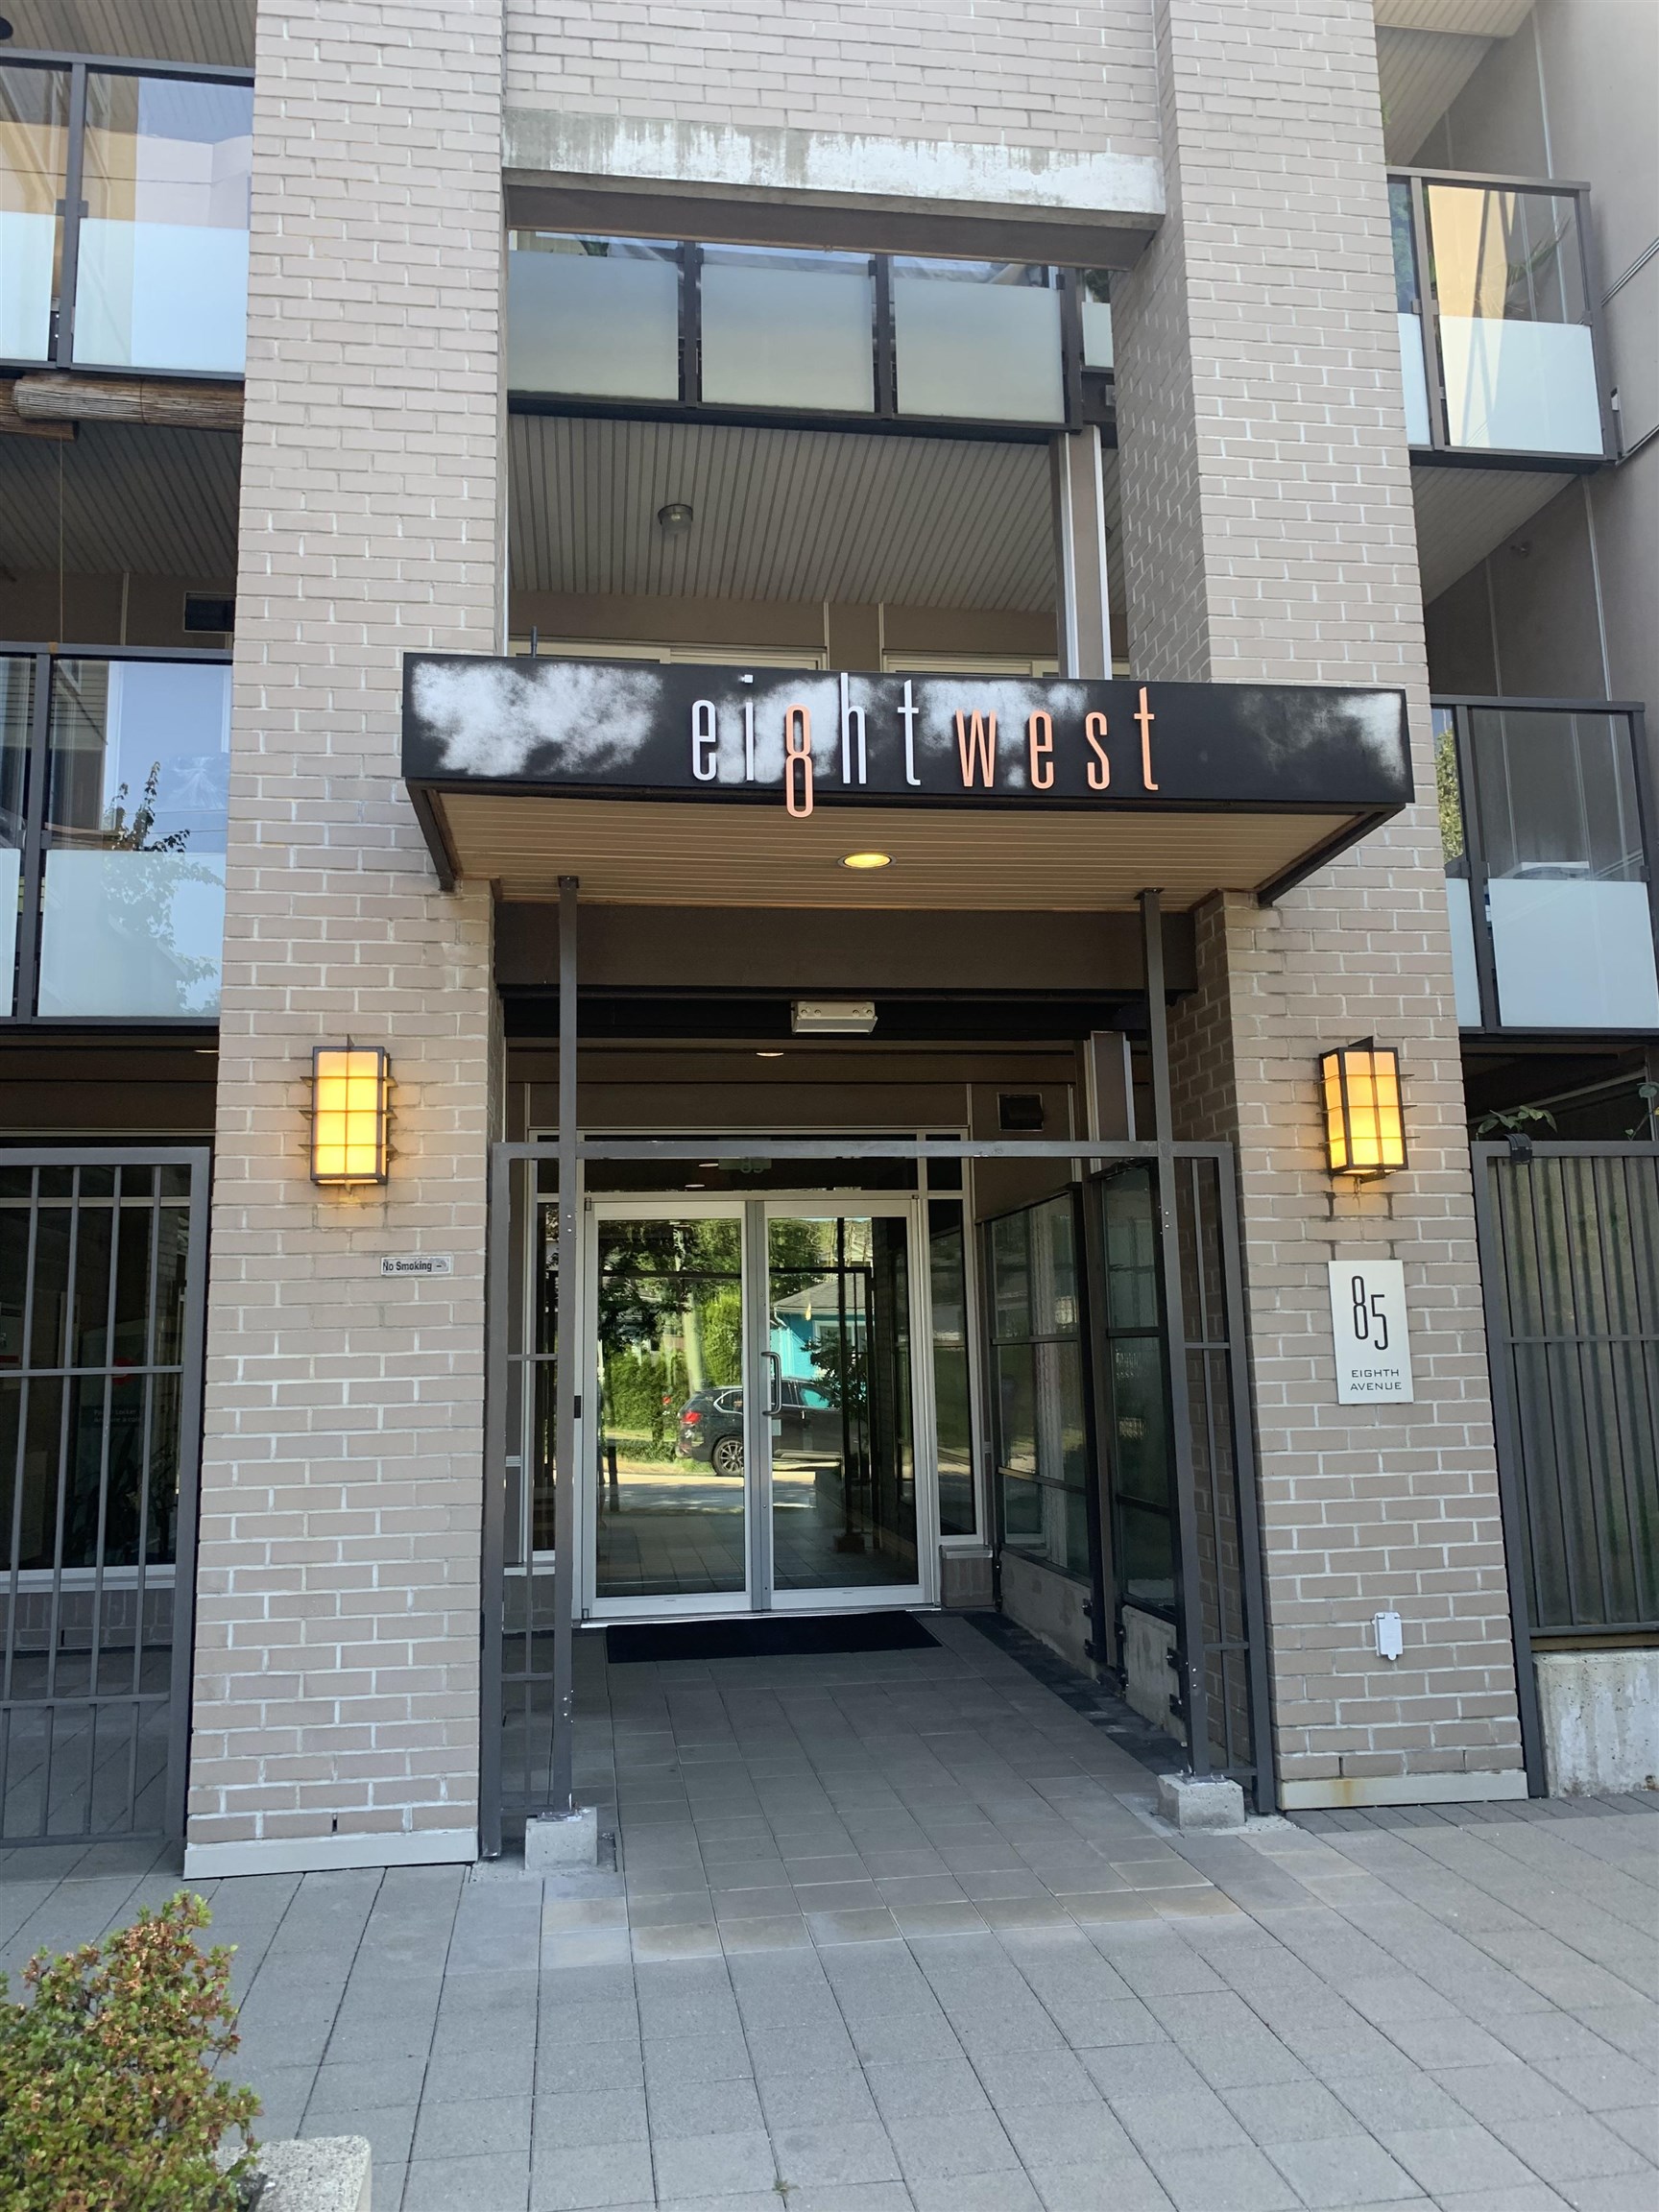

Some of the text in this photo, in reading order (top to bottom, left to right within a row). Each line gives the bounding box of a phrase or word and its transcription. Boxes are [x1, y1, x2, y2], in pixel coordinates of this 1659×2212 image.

[382, 1260, 432, 1273] No Smoking
[1351, 1275, 1389, 1351] 85
[1351, 1368, 1400, 1379] EIGHTH
[1350, 1382, 1403, 1391] AVENUE
